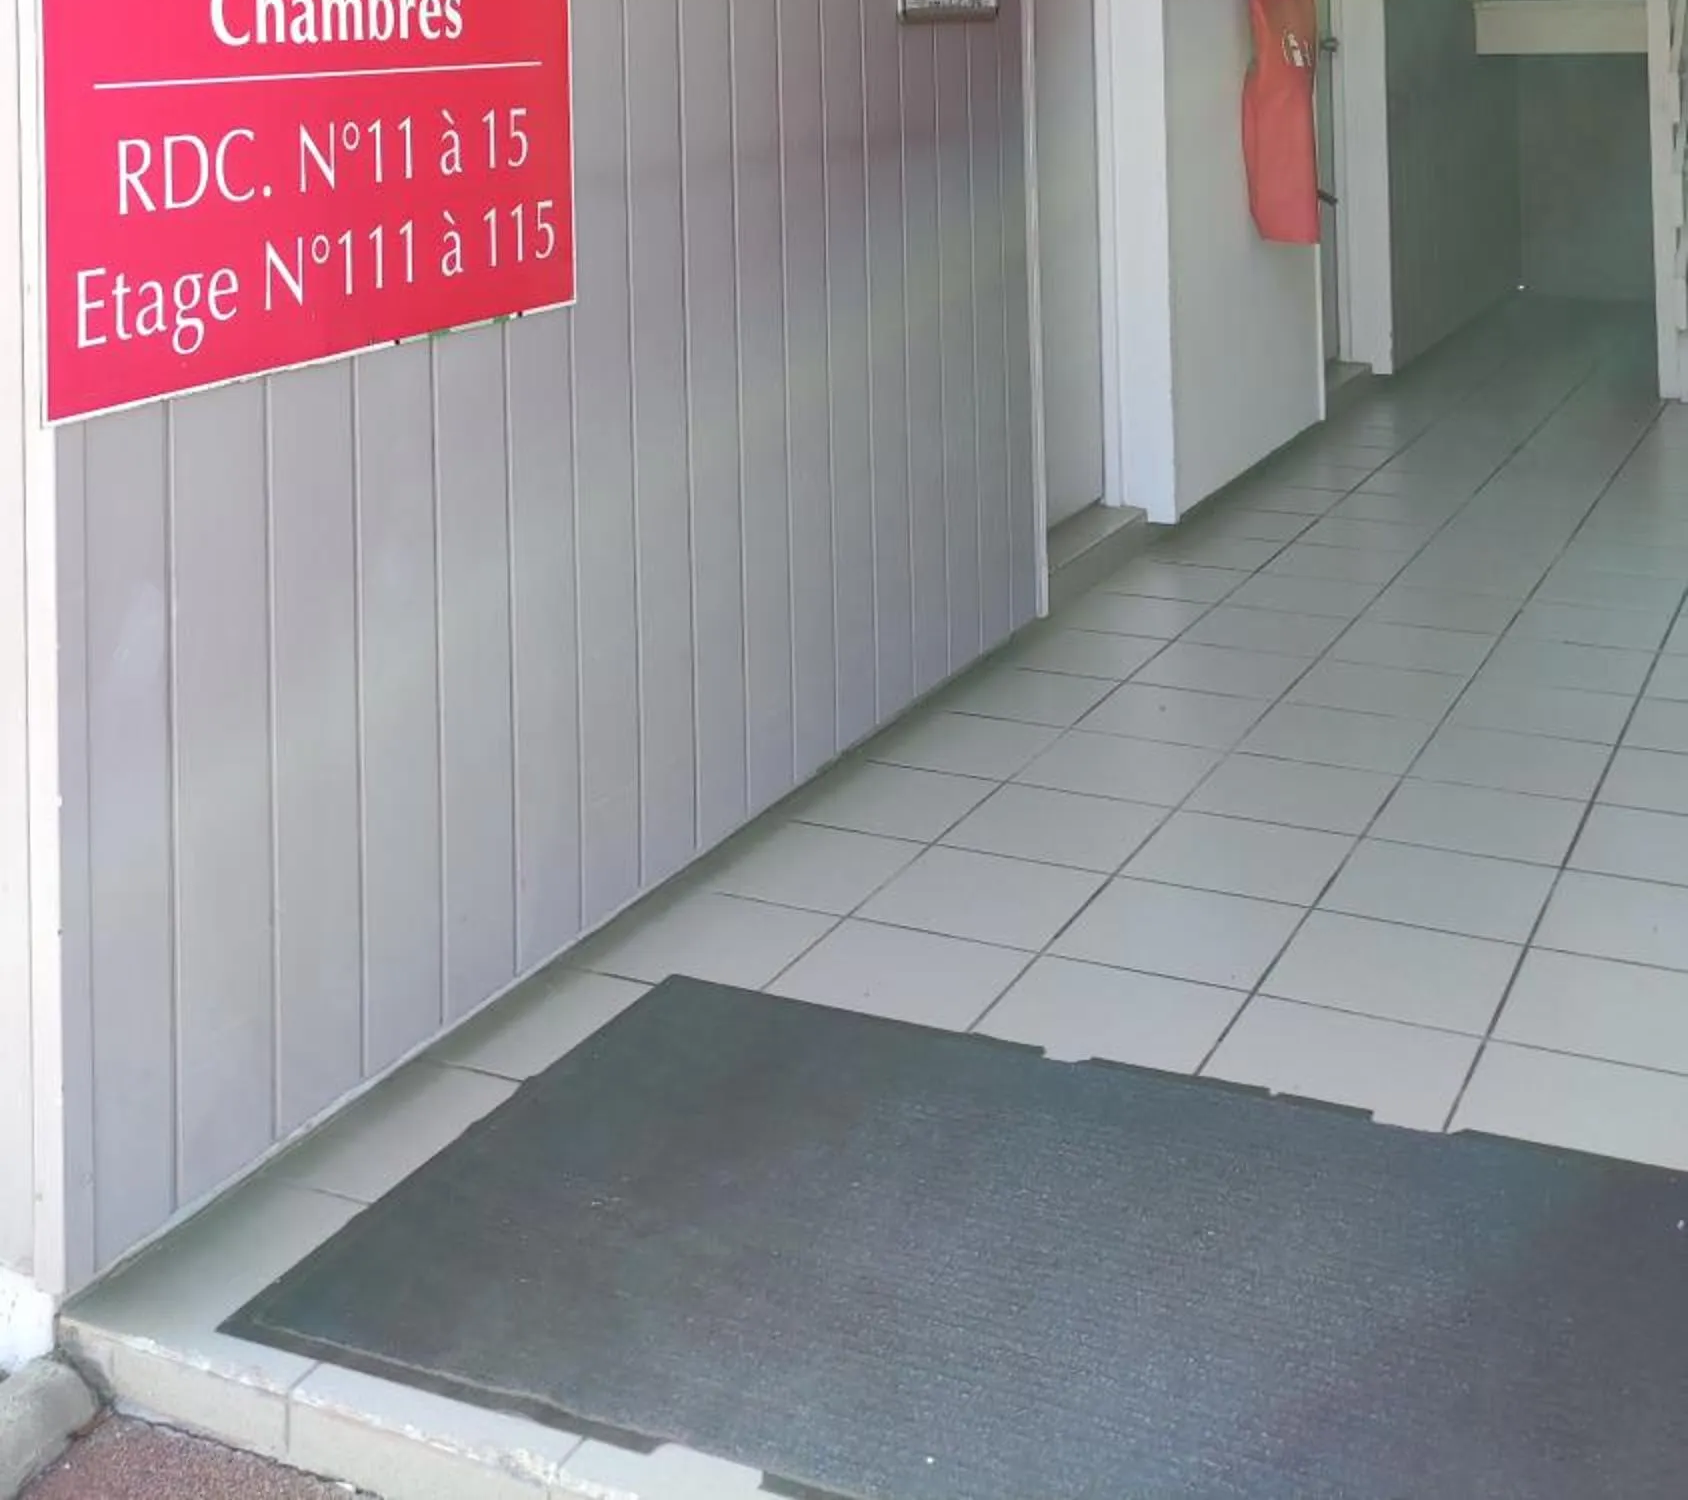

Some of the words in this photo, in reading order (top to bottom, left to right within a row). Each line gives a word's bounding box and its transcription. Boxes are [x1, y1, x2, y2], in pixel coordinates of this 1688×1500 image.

[117, 128, 272, 216] RDC.
[440, 109, 463, 175] à
[482, 108, 529, 169] 15
[76, 267, 239, 356] Etage
[441, 211, 463, 277] à
[484, 200, 555, 268] 115
